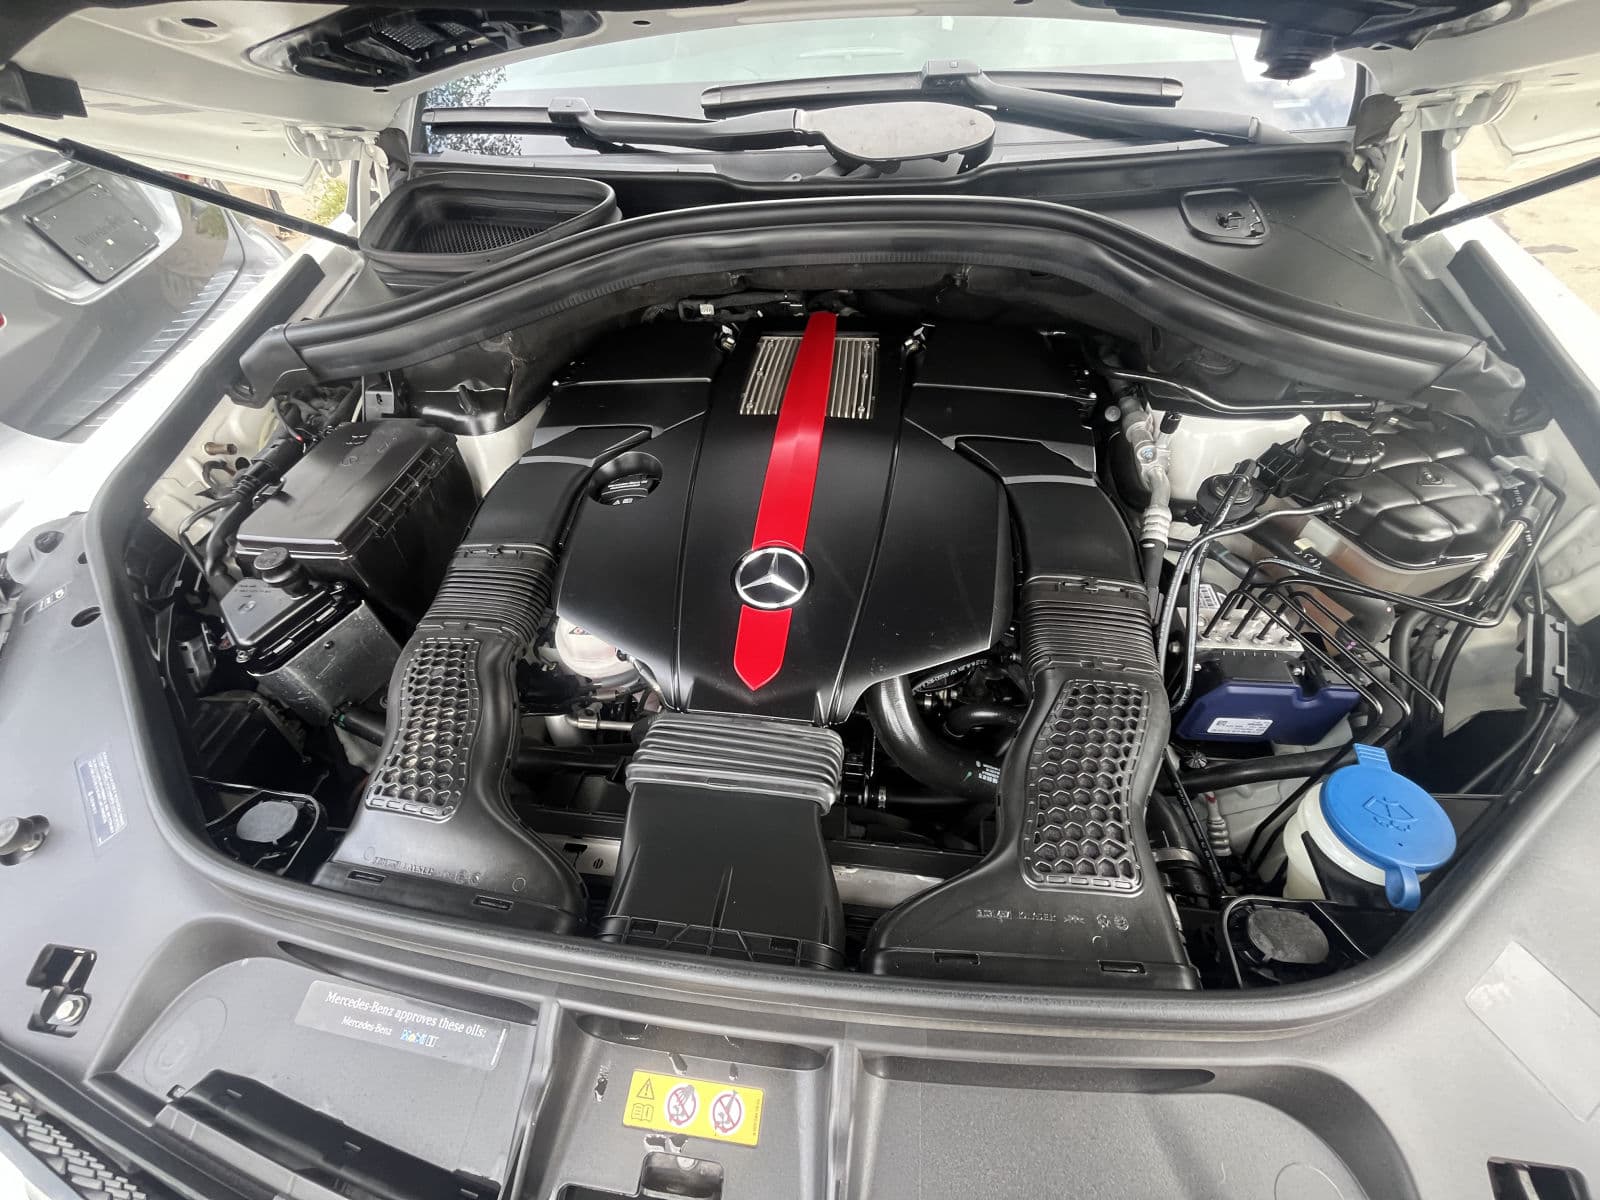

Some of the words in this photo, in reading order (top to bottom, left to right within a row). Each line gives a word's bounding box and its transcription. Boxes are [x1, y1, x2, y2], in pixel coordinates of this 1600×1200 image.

[326, 991, 394, 1017] Mercedes-Benz
[394, 1009, 437, 1027] approves
[438, 1016, 464, 1033] these
[341, 1016, 393, 1035] Mercedes-Benz
